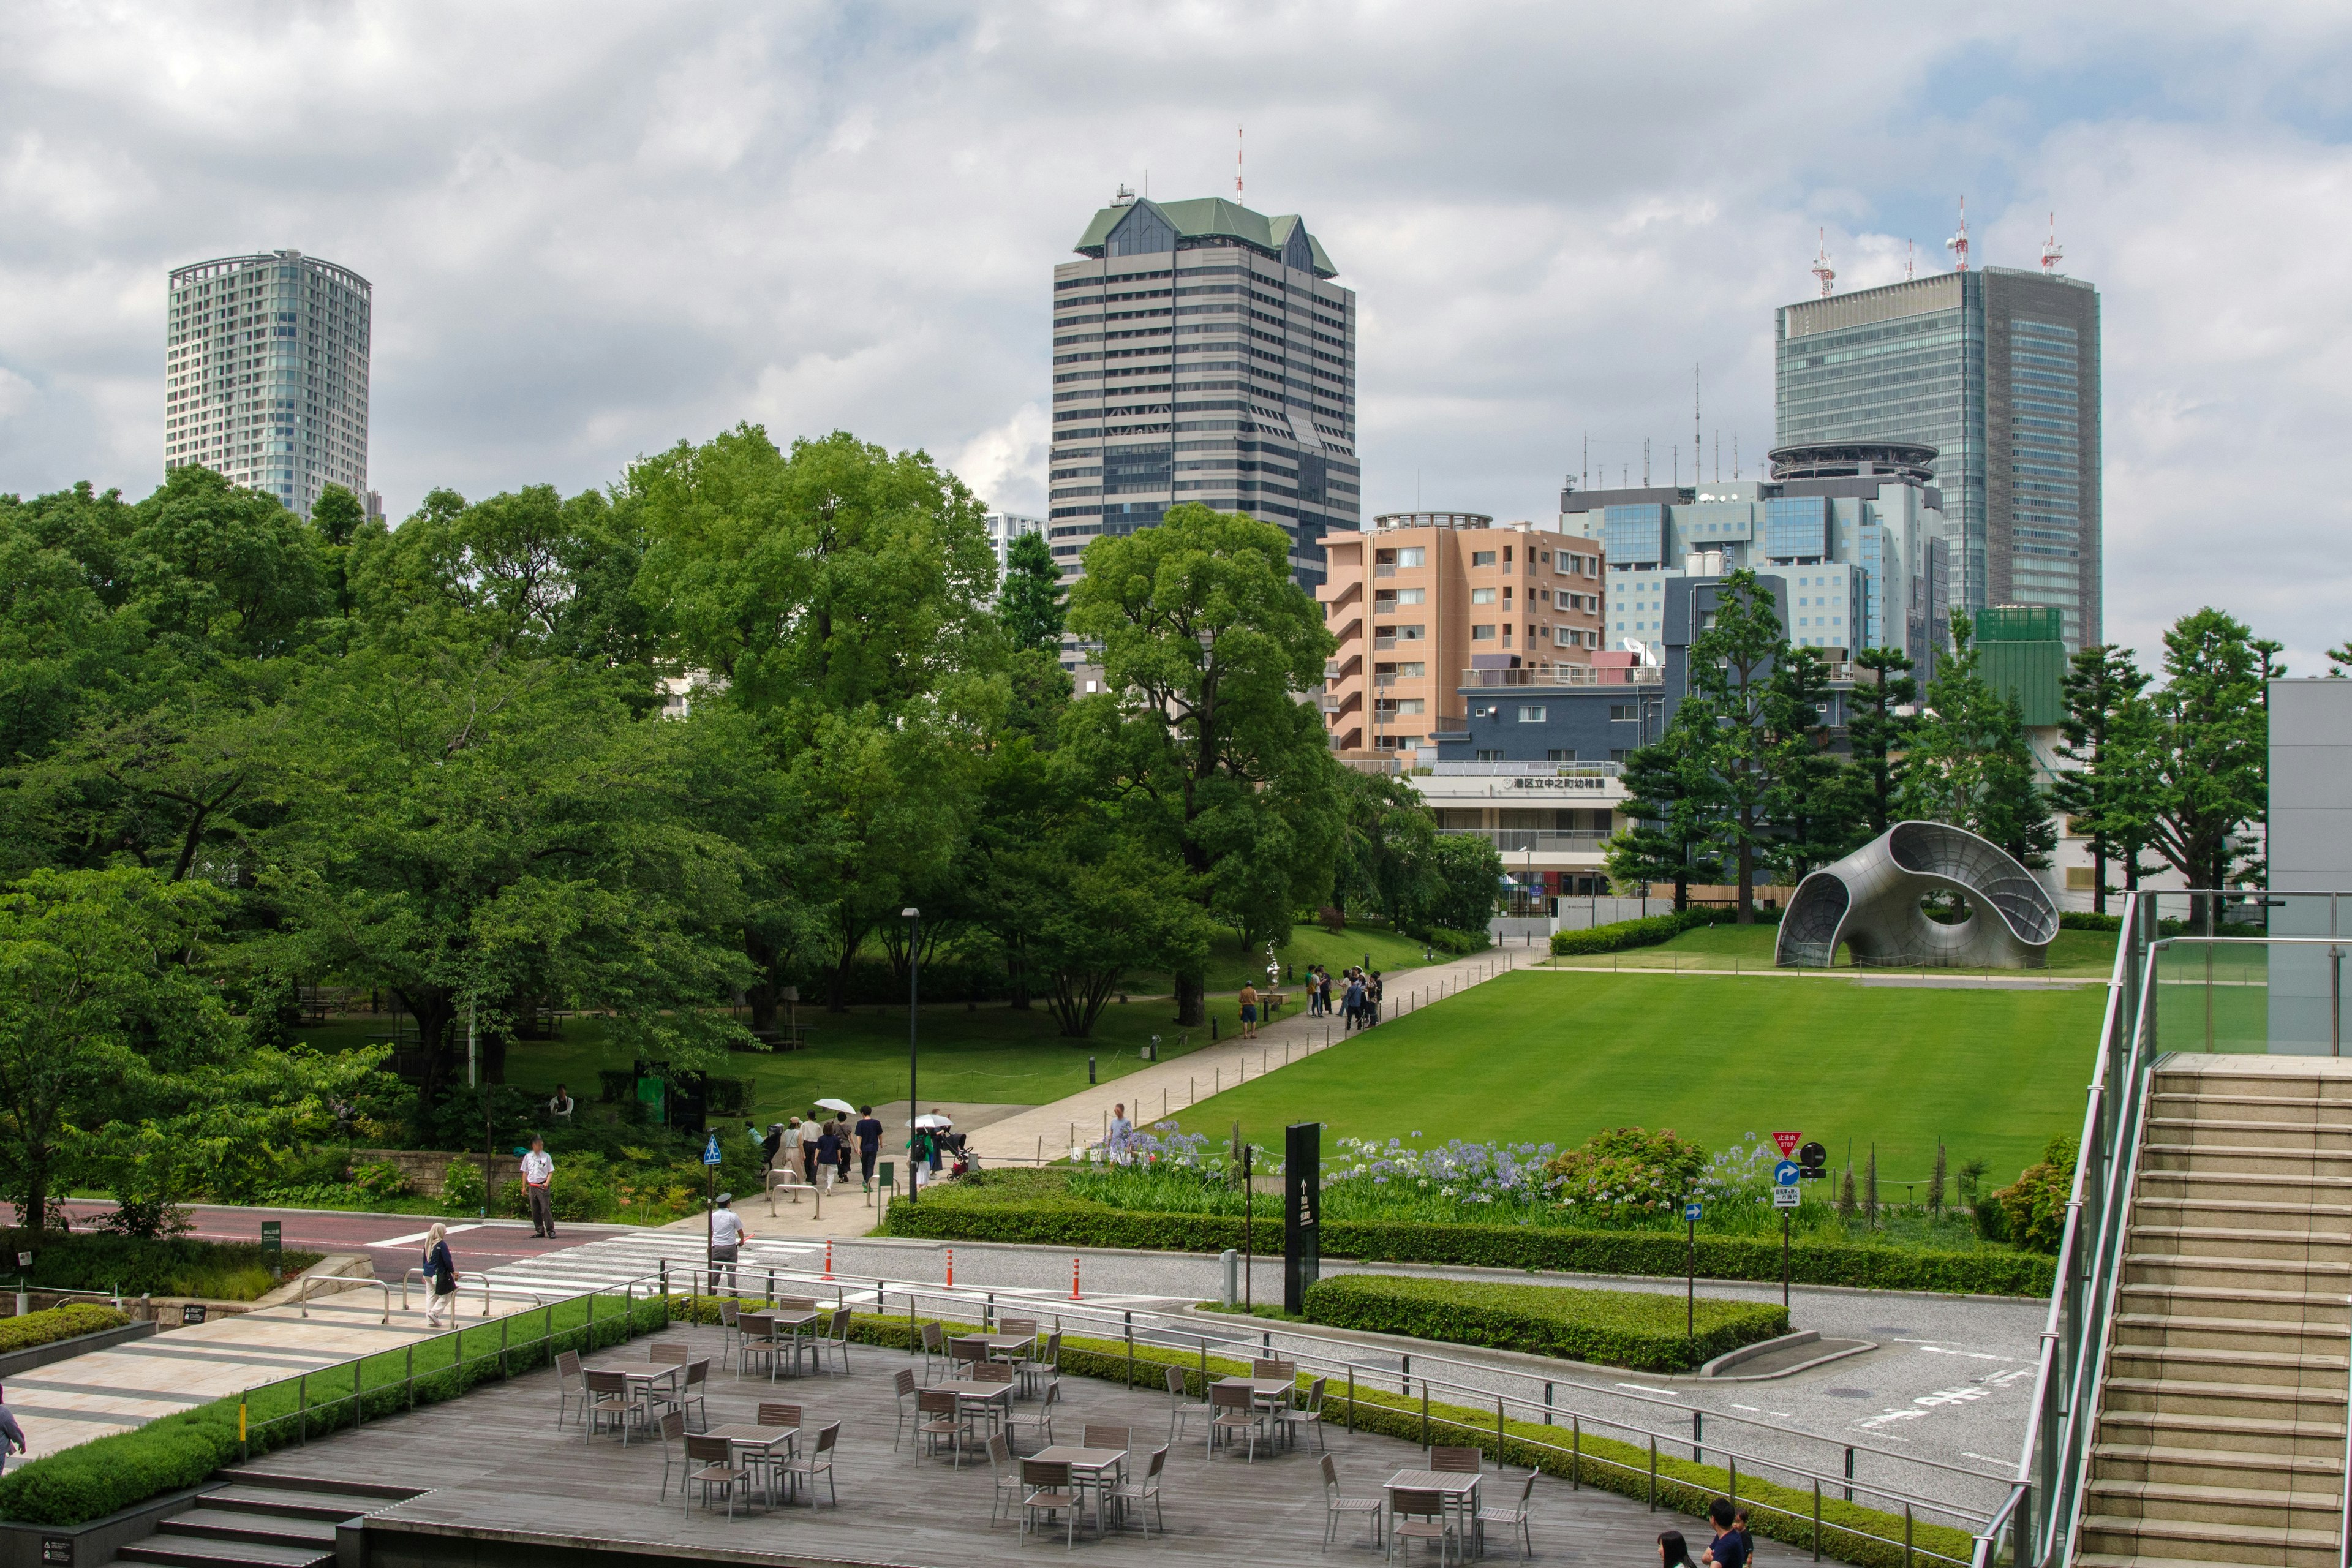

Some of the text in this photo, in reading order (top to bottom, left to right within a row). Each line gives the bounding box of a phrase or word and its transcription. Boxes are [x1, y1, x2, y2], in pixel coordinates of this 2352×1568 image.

[1514, 778, 1605, 788] 港区立中之町幼稚園
